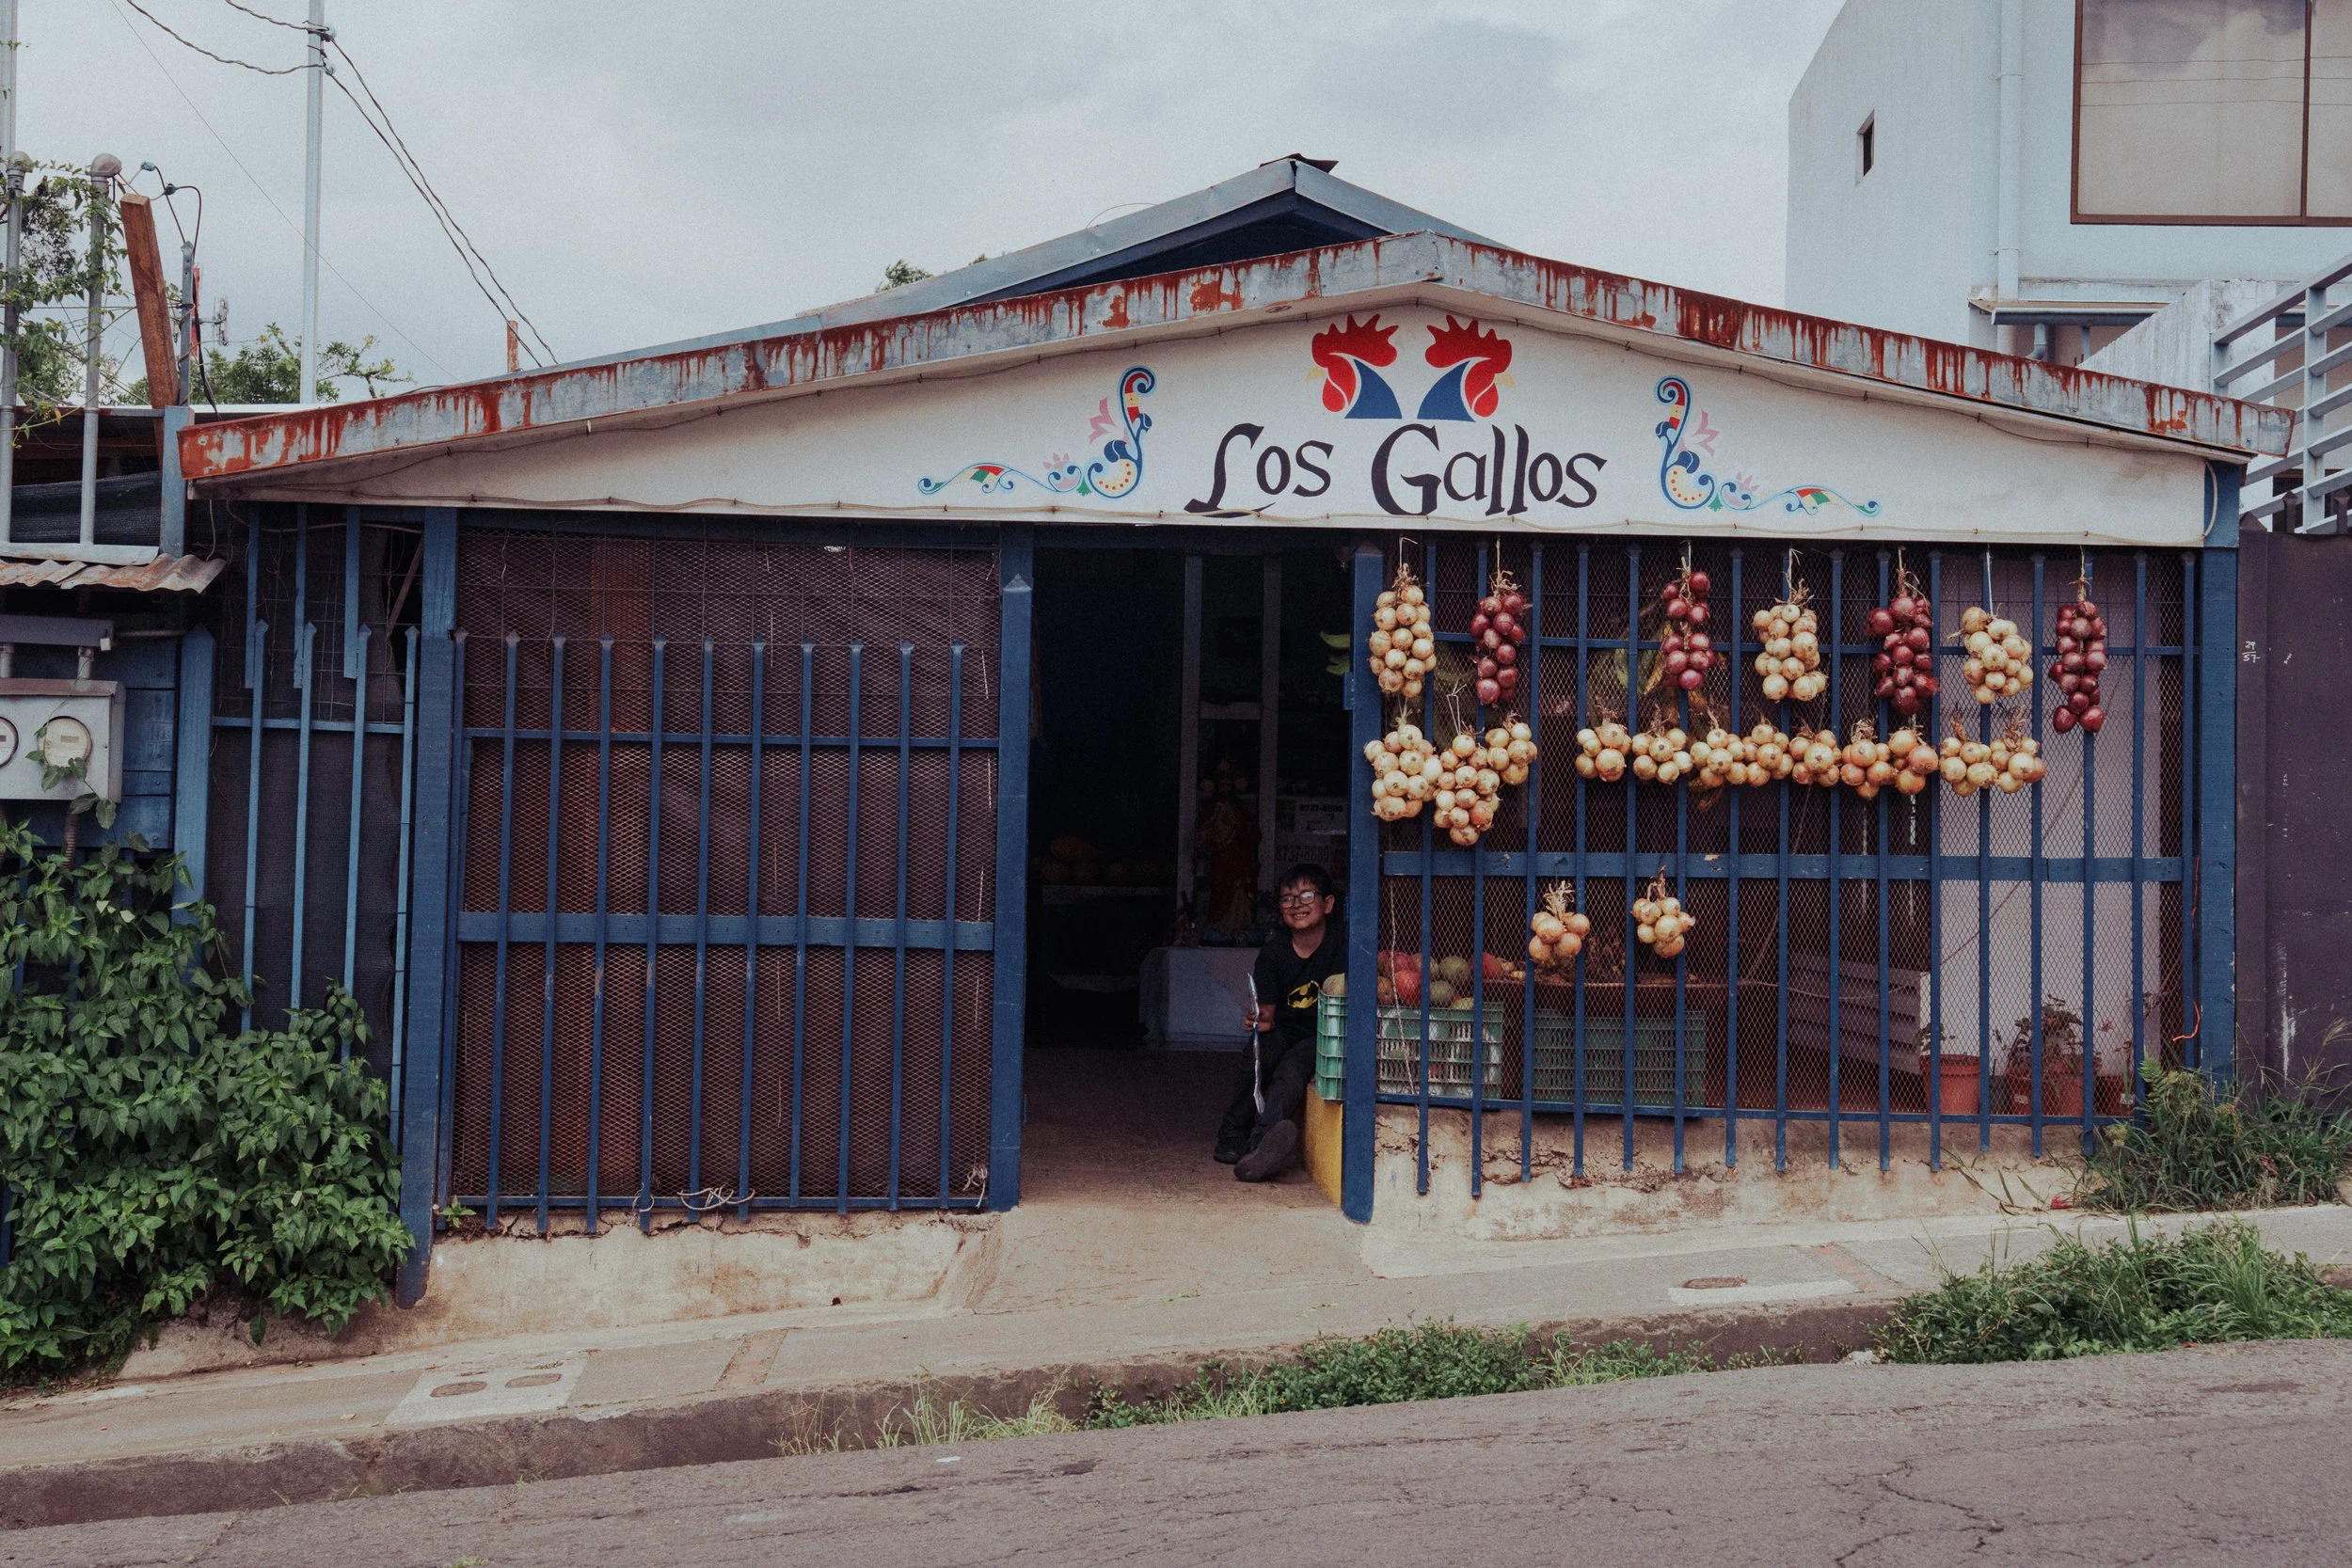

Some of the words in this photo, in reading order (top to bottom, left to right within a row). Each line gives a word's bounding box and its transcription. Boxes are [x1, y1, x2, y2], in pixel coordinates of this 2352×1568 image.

[1184, 423, 1334, 517] Los
[1372, 423, 1608, 515] Gallos
[2245, 641, 2256, 650] 29
[2243, 654, 2261, 663] 57
